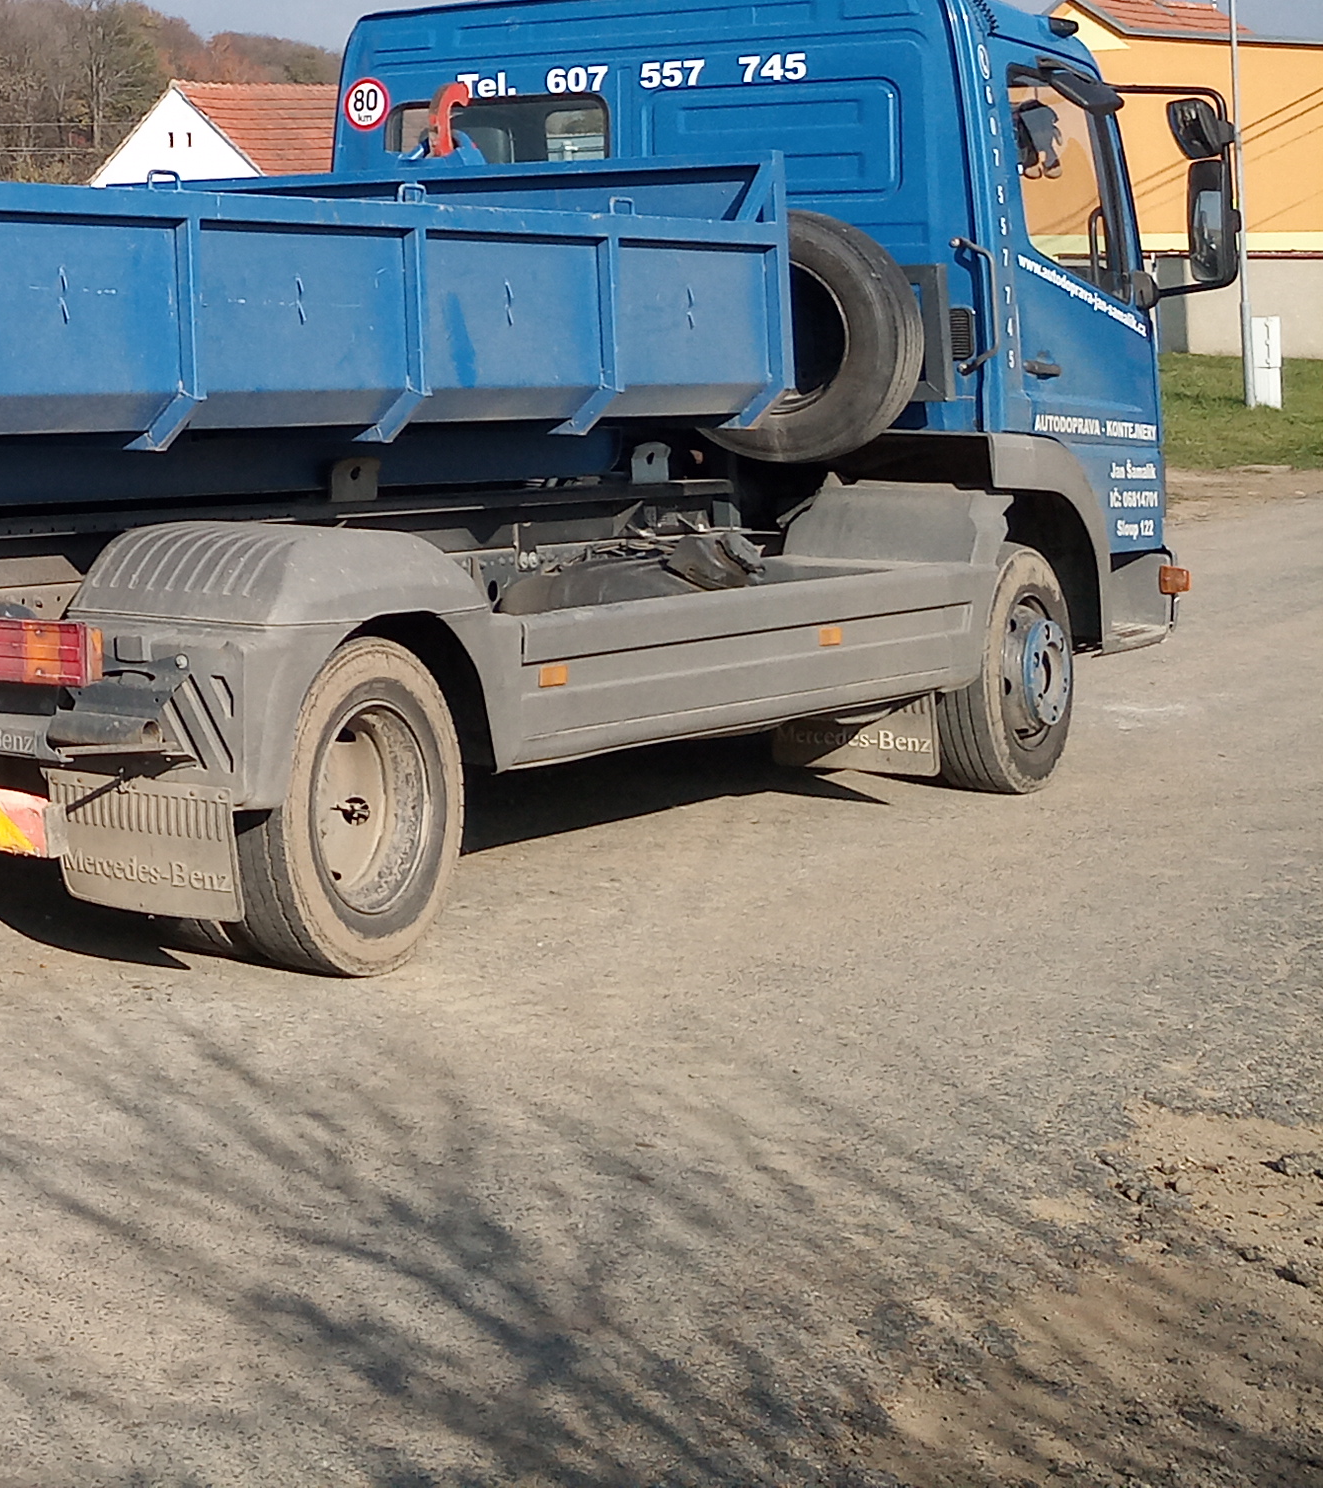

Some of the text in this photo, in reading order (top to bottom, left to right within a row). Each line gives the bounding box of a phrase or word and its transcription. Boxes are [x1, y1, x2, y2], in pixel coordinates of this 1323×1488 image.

[457, 53, 807, 98] Tel. 607 557 745
[354, 88, 378, 112] 80
[357, 113, 373, 122] km
[1034, 414, 1102, 436] AUTODOPRAVA
[1106, 420, 1157, 441] KONTEJNERY
[1110, 462, 1126, 480] Jan
[775, 725, 932, 753] Mercedes-Benz
[63, 847, 233, 893] Mercedes-Benz
